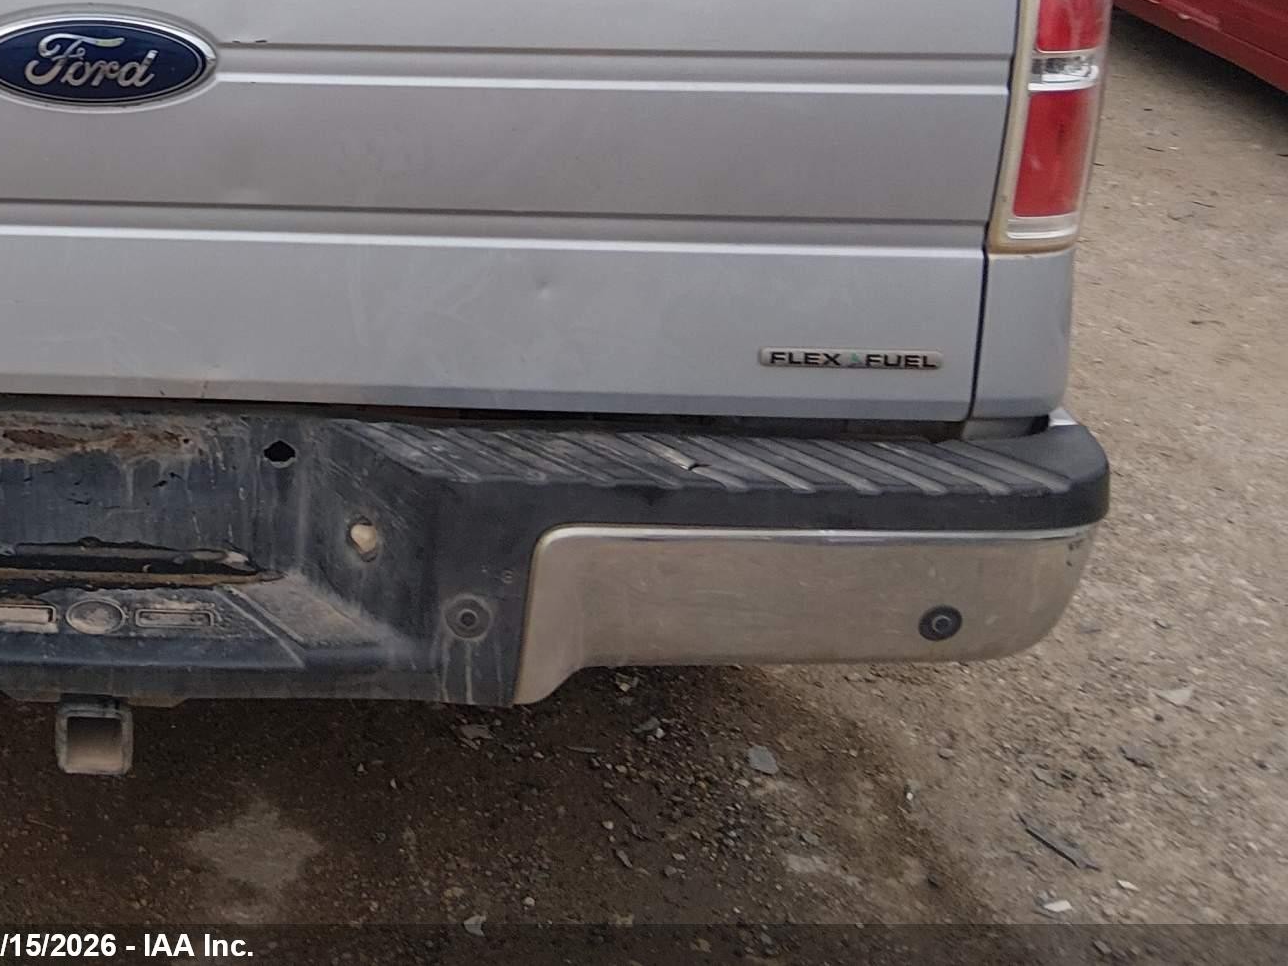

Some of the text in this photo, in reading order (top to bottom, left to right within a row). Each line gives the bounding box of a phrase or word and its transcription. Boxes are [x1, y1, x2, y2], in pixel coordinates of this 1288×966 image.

[24, 33, 159, 87] Ford
[769, 351, 937, 369] FLEX FUEL
